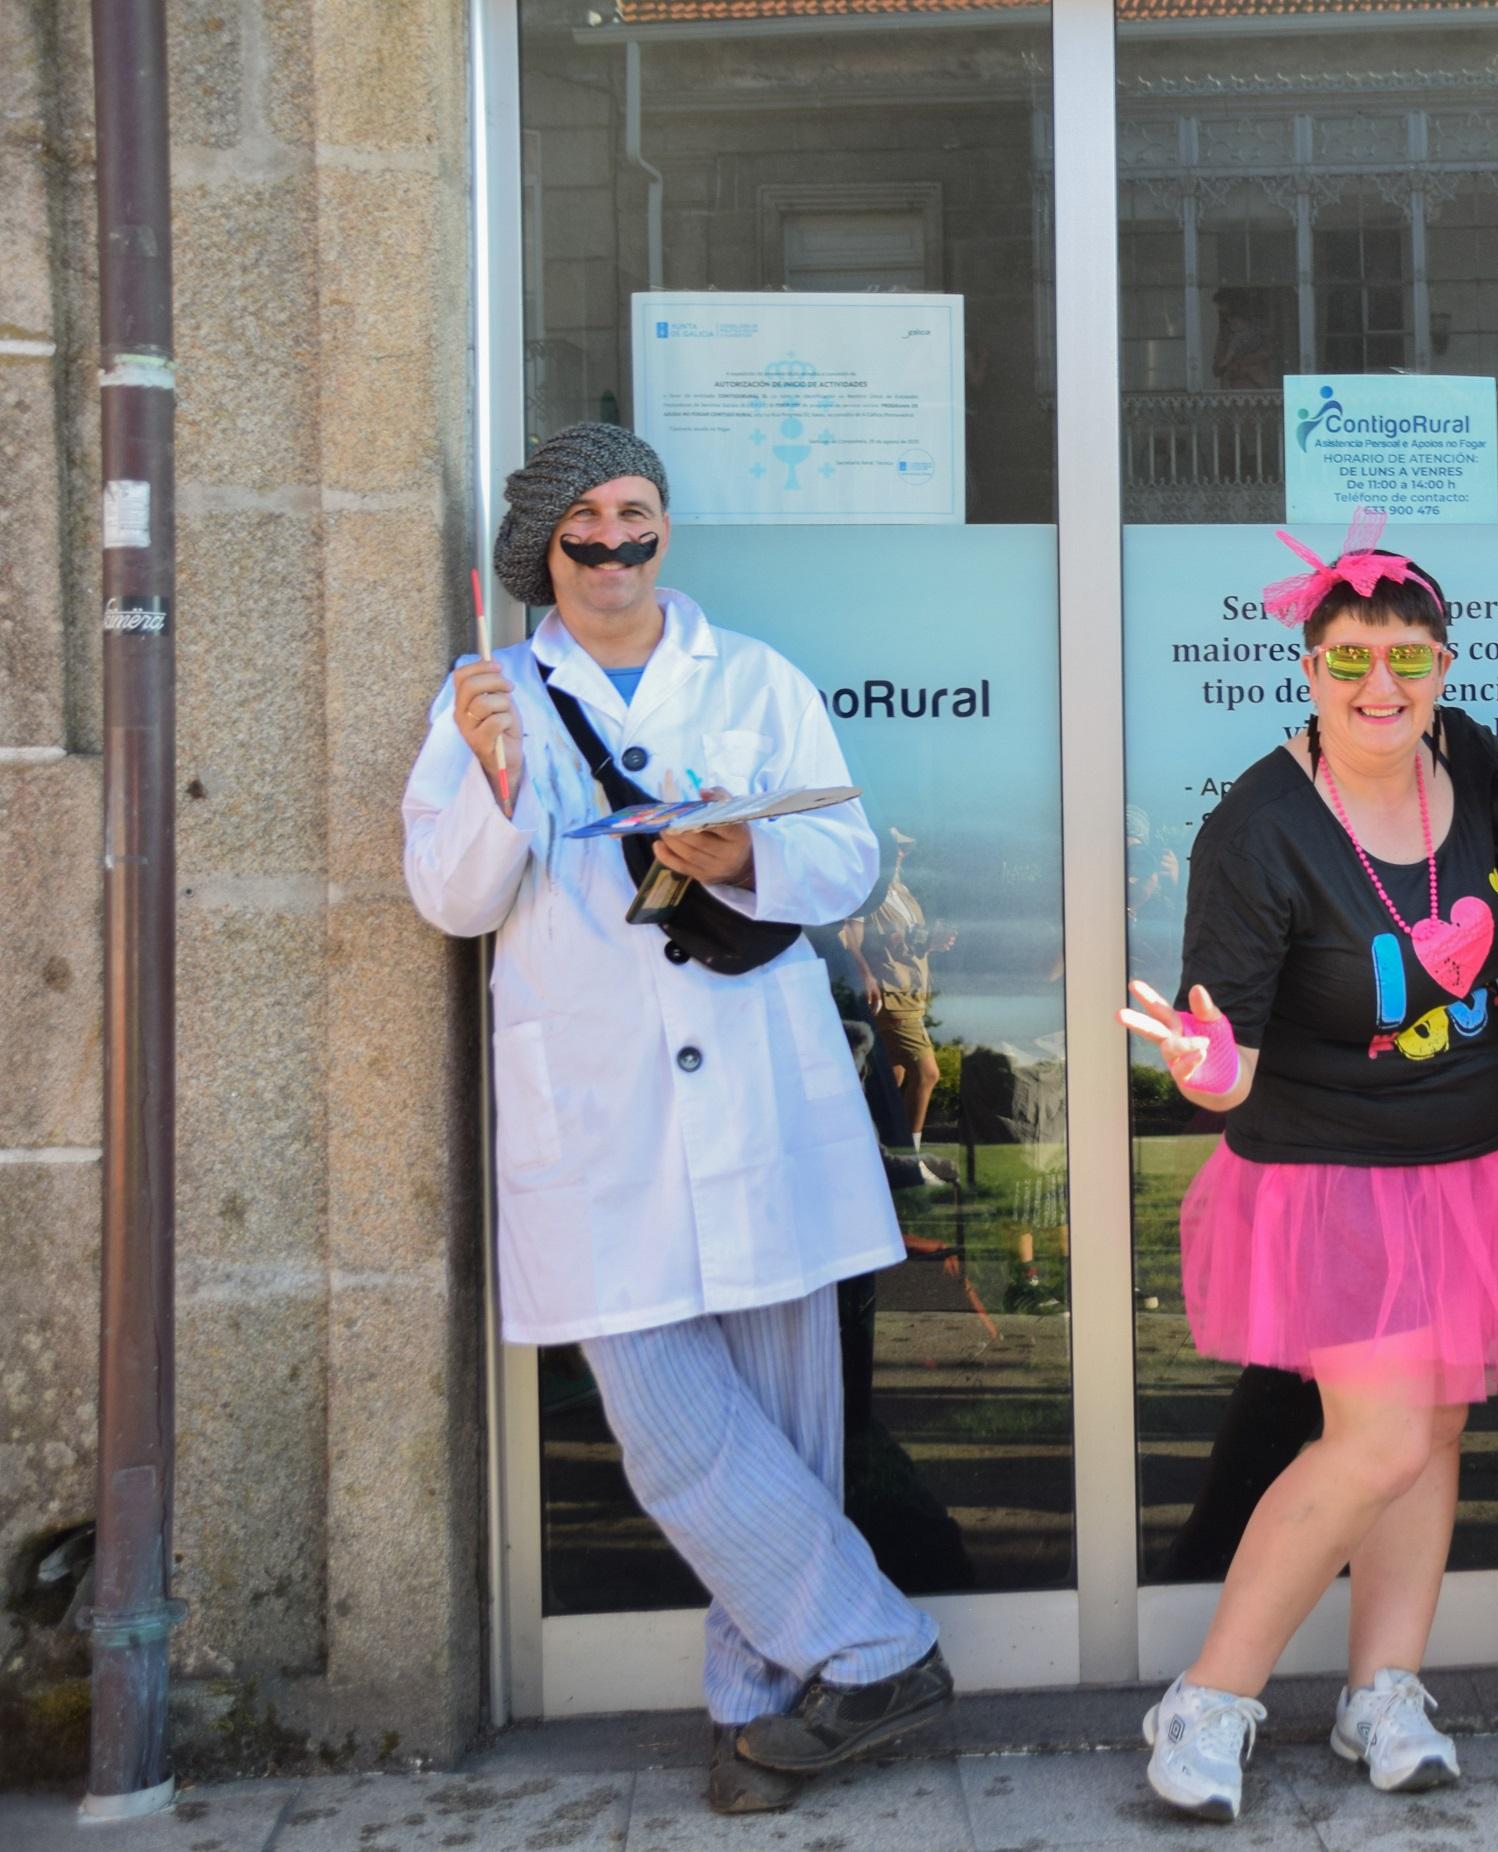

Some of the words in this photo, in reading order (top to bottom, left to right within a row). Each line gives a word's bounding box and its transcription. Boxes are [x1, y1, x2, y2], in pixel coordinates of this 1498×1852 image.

[1325, 414, 1470, 438] ContigoRural
[1314, 439, 1363, 448] Asistencia
[1365, 439, 1400, 448] Persoal
[1411, 439, 1445, 450] Apoios
[1459, 439, 1487, 450] Fogar
[1323, 454, 1384, 464] HORARIO
[1388, 454, 1406, 464] DE
[1409, 452, 1479, 464] ATENCIÓN:
[1339, 467, 1357, 476] DE
[1361, 467, 1395, 476] LUNS
[1399, 467, 1408, 476] A
[1412, 467, 1463, 476] VENRES
[1347, 480, 1364, 489] De
[1368, 480, 1397, 489] 11:00
[1411, 480, 1444, 489] 14:00
[1447, 480, 1456, 489] h
[1335, 492, 1388, 502] Teléfono
[1391, 493, 1407, 502] de
[1410, 494, 1469, 502] contacto:
[1364, 505, 1387, 515] 633
[1389, 505, 1413, 515] 900
[1417, 505, 1440, 515] 476
[1172, 637, 1300, 662] maiores
[820, 679, 990, 719] oRural
[1202, 678, 1265, 711] tipo
[1275, 678, 1310, 704] de
